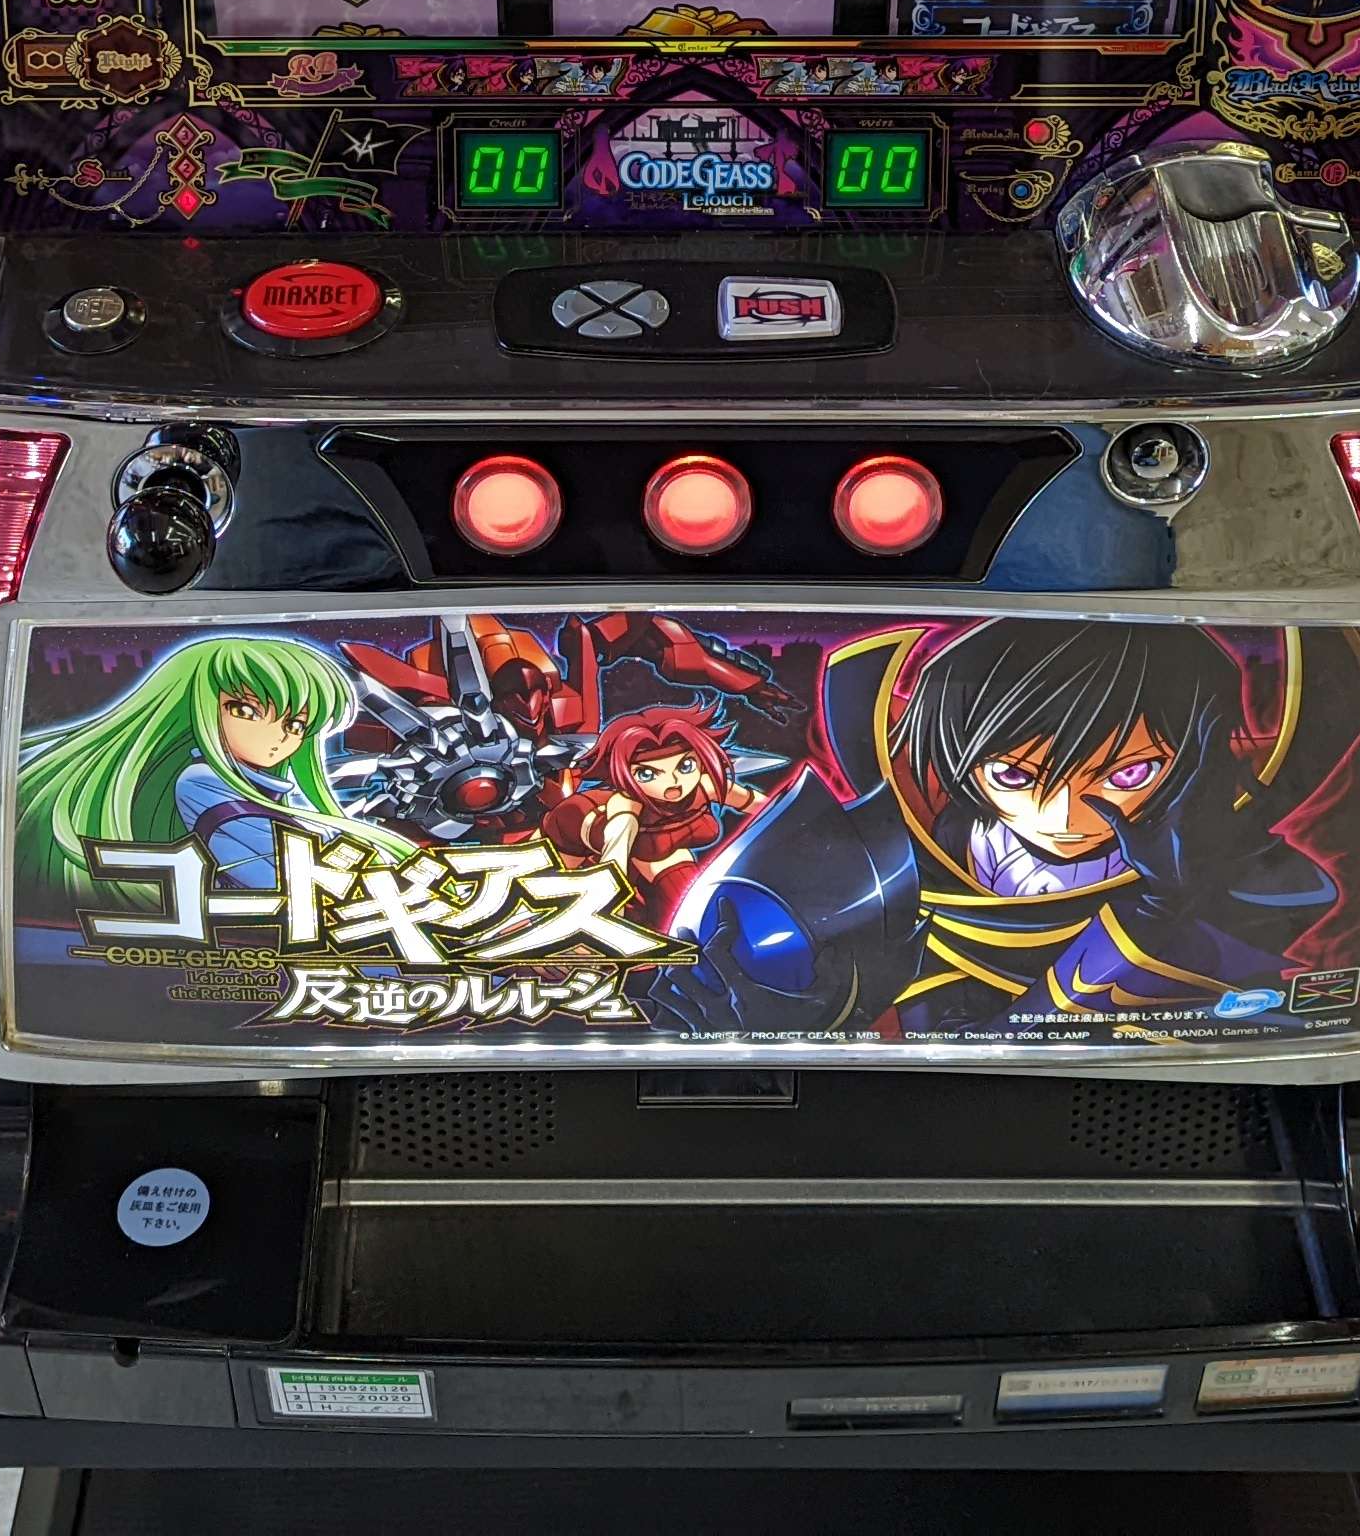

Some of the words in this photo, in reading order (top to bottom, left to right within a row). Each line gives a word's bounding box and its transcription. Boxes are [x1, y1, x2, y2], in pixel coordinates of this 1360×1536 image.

[1228, 70, 1298, 96] Black
[489, 118, 528, 128] Credit
[469, 147, 549, 194] 00
[838, 146, 918, 194] 00
[966, 184, 1006, 194] Replay
[683, 192, 753, 211] Lelouch
[263, 282, 364, 307] MAXBET
[738, 297, 823, 319] PUSH
[93, 830, 660, 964] コードギアス
[107, 947, 180, 965] CODE
[187, 948, 278, 969] GEASS
[190, 970, 254, 985] Lelouch
[257, 972, 278, 985] of
[171, 987, 198, 999] the
[201, 987, 279, 1001] Rebellion
[272, 968, 641, 1022] 反逆のルルーシュ
[1009, 1010, 1210, 1025] 全配当表記は液晶に表示してあります。
[1315, 1017, 1352, 1029] Sammy
[905, 1031, 961, 1041] Character
[964, 1031, 1003, 1042] Design
[1017, 1031, 1044, 1040] 2006
[1047, 1031, 1091, 1041] CLAMP
[1124, 1030, 1169, 1040] NAMCO
[1173, 1028, 1219, 1038] BANDAI
[1222, 1027, 1260, 1037] Games
[1263, 1025, 1283, 1034] Inc.
[137, 1185, 197, 1198] 備え付けの
[129, 1200, 201, 1215] 灰皿をご使用
[142, 1217, 181, 1231] 下さい。
